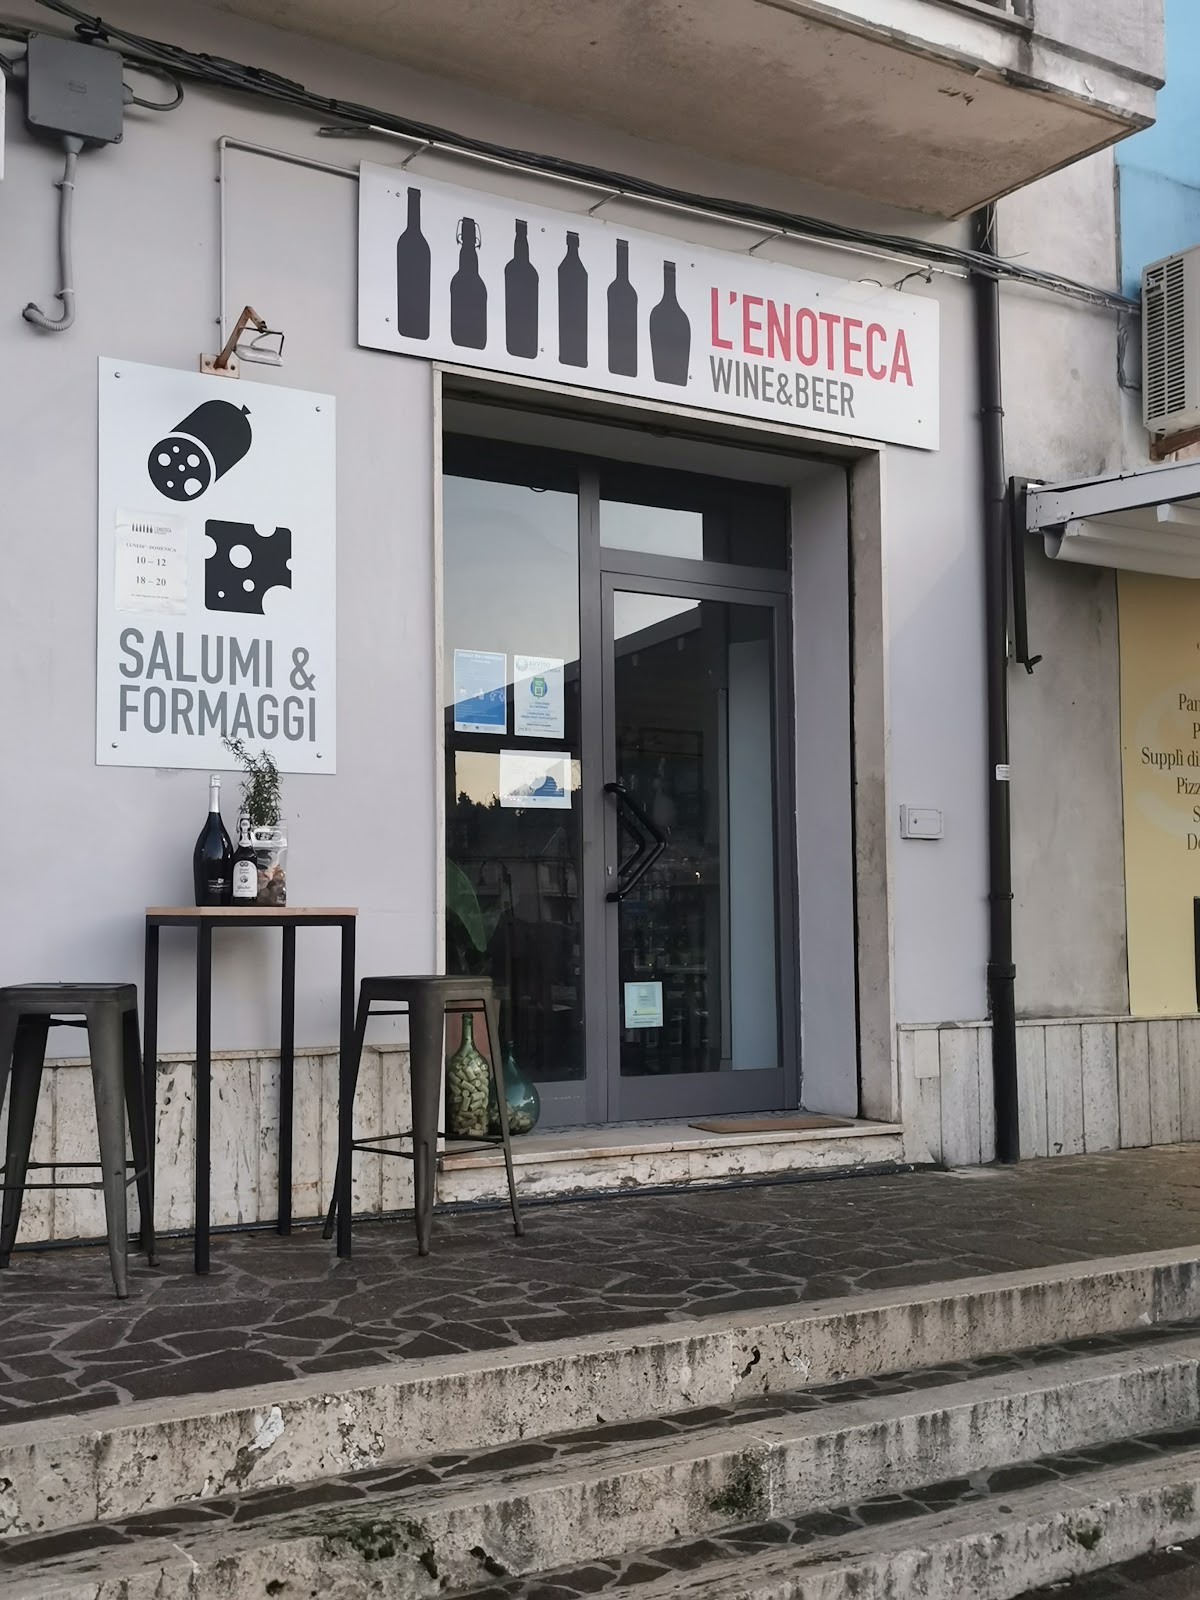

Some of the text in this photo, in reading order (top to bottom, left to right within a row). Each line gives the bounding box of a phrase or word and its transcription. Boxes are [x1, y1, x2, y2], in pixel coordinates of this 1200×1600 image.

[711, 287, 913, 387] L'ENOTECA
[709, 355, 855, 418] WINE&BEER
[136, 556, 146, 564] 10
[157, 558, 166, 566] 12
[136, 575, 146, 584] 18
[156, 578, 166, 586] 20
[118, 627, 316, 691] SALUMI &
[119, 684, 316, 743] FORMAGGI
[1141, 746, 1199, 770] Supplì di
